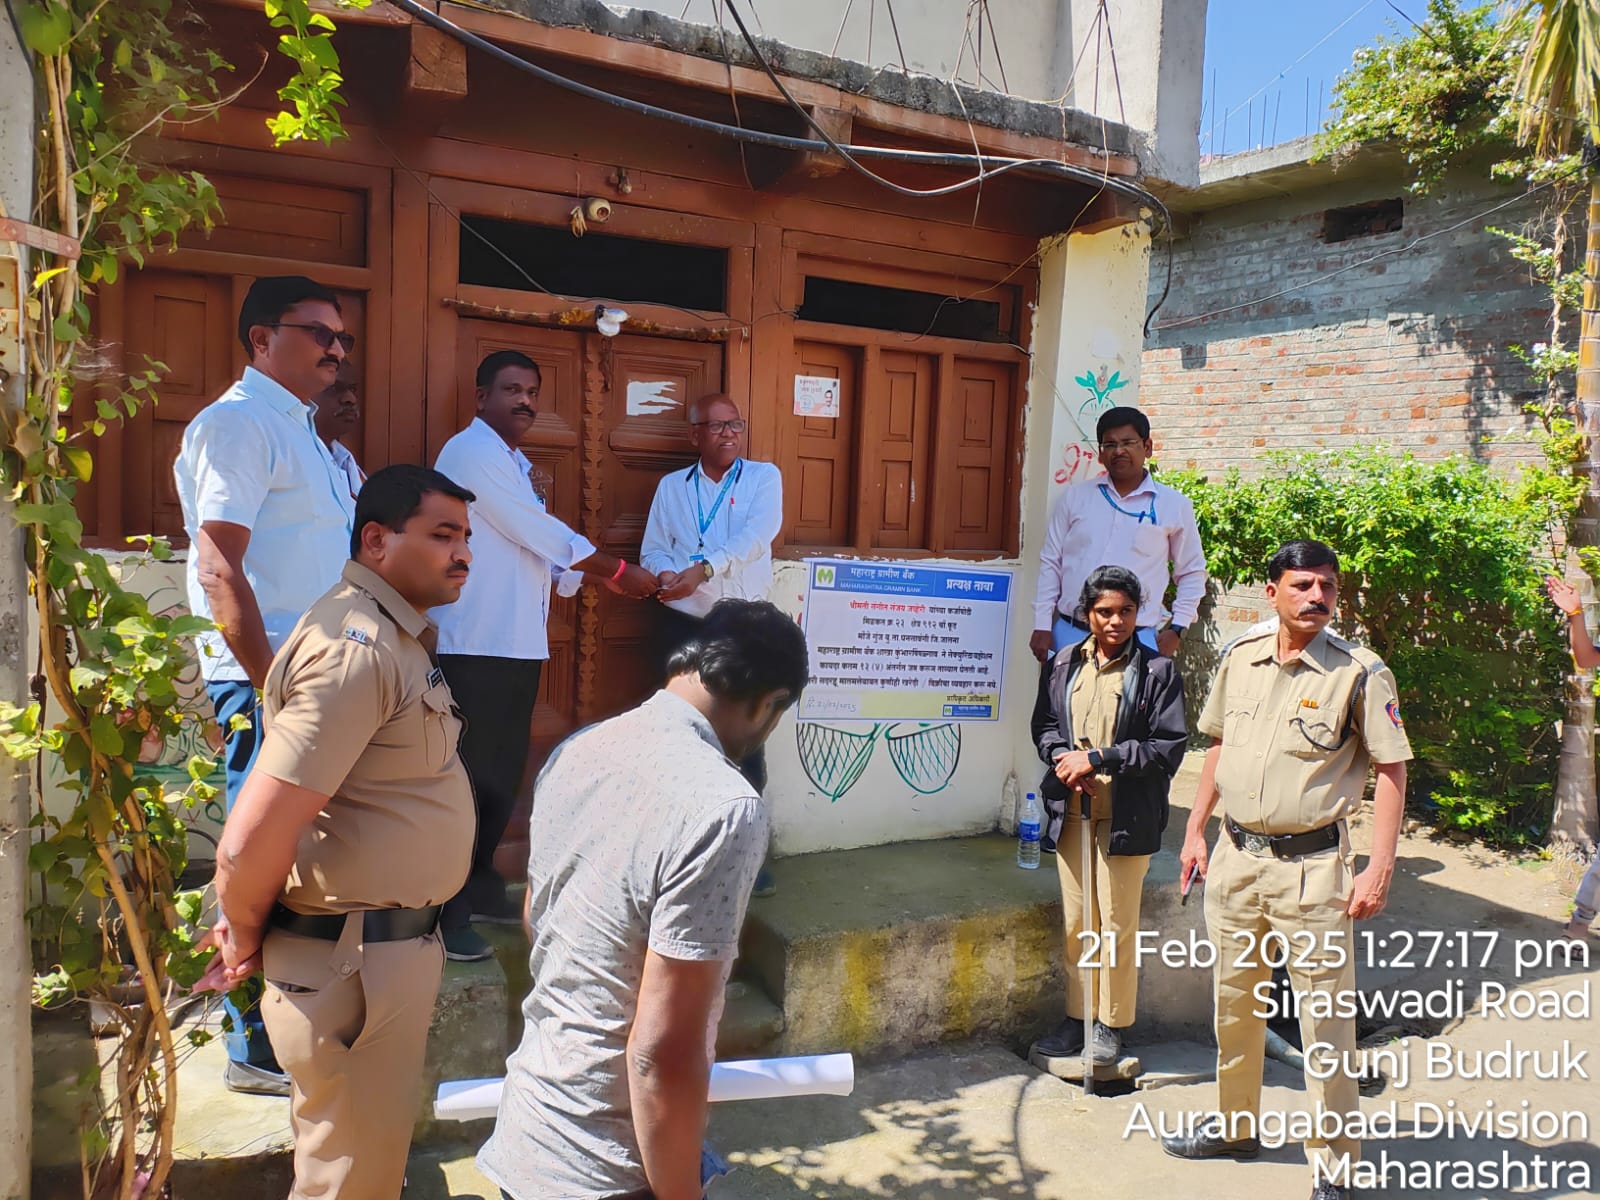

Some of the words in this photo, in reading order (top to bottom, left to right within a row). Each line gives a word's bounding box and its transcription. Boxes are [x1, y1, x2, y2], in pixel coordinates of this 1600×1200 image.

[851, 567, 875, 579] महाराष्ट्र
[877, 567, 899, 579] ग्रामीण
[902, 567, 915, 580] बँक
[840, 581, 882, 590] MAHARASHTRA
[946, 579, 972, 592] प्रत्यक्ष
[973, 580, 994, 592] ताबा
